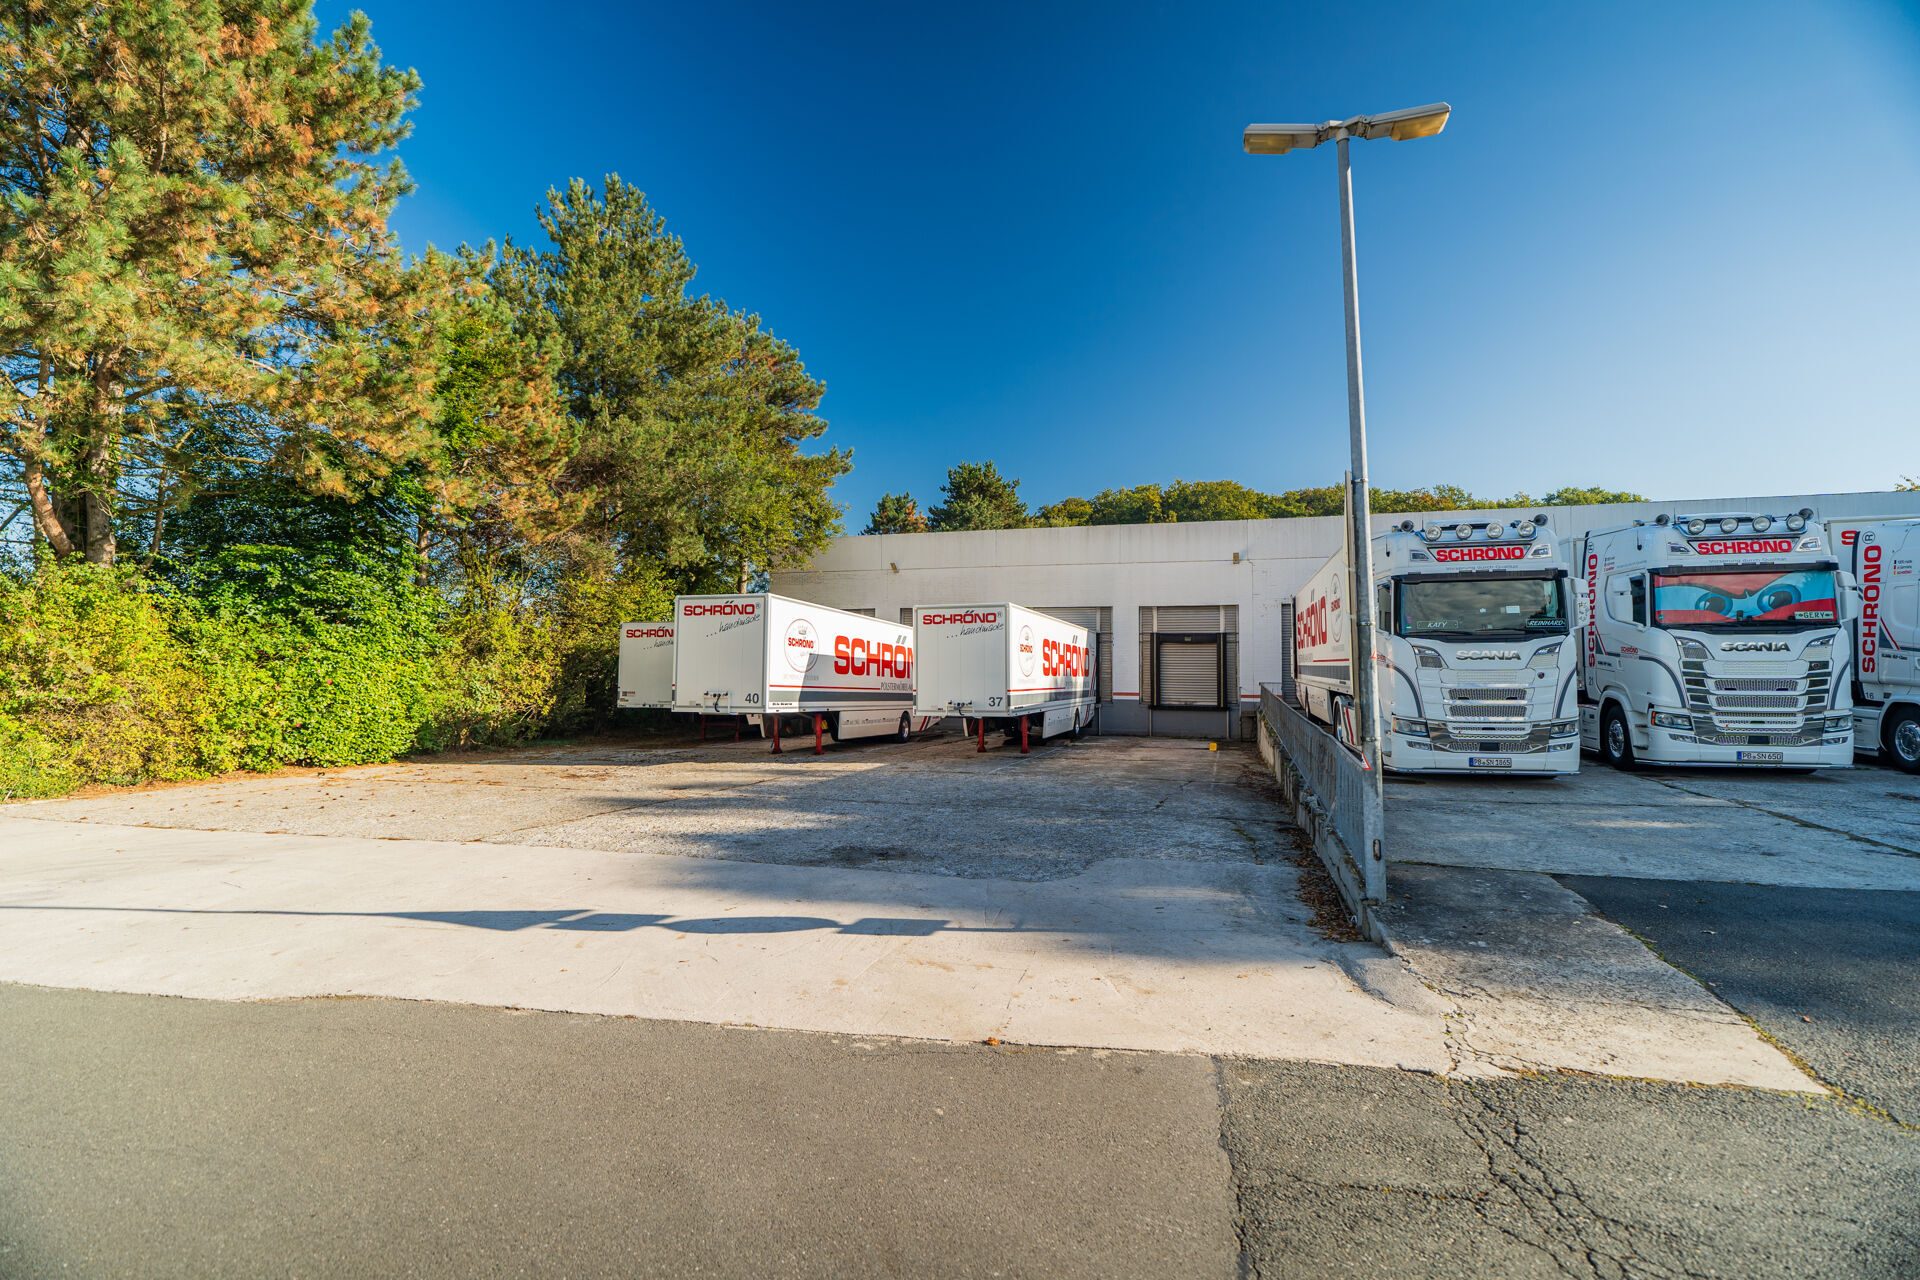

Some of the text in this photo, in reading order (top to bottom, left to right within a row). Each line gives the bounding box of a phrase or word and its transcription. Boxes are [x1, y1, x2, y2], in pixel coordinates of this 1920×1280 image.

[1436, 545, 1524, 562] SCHRÖNO
[1697, 539, 1793, 555] SCHRÖNO
[683, 600, 756, 616] SCHRÖNO
[1858, 545, 1882, 673] SCHRÖNO
[922, 610, 997, 625] SCHRÖNO
[1298, 589, 1327, 650] SCHRÖNO
[1428, 620, 1448, 628] KATY
[1720, 641, 1791, 652] SCANIA
[1042, 635, 1090, 677] SCHRÖNO
[1456, 650, 1521, 661] SCANIA
[745, 693, 760, 704] 40
[988, 696, 1003, 707] 37
